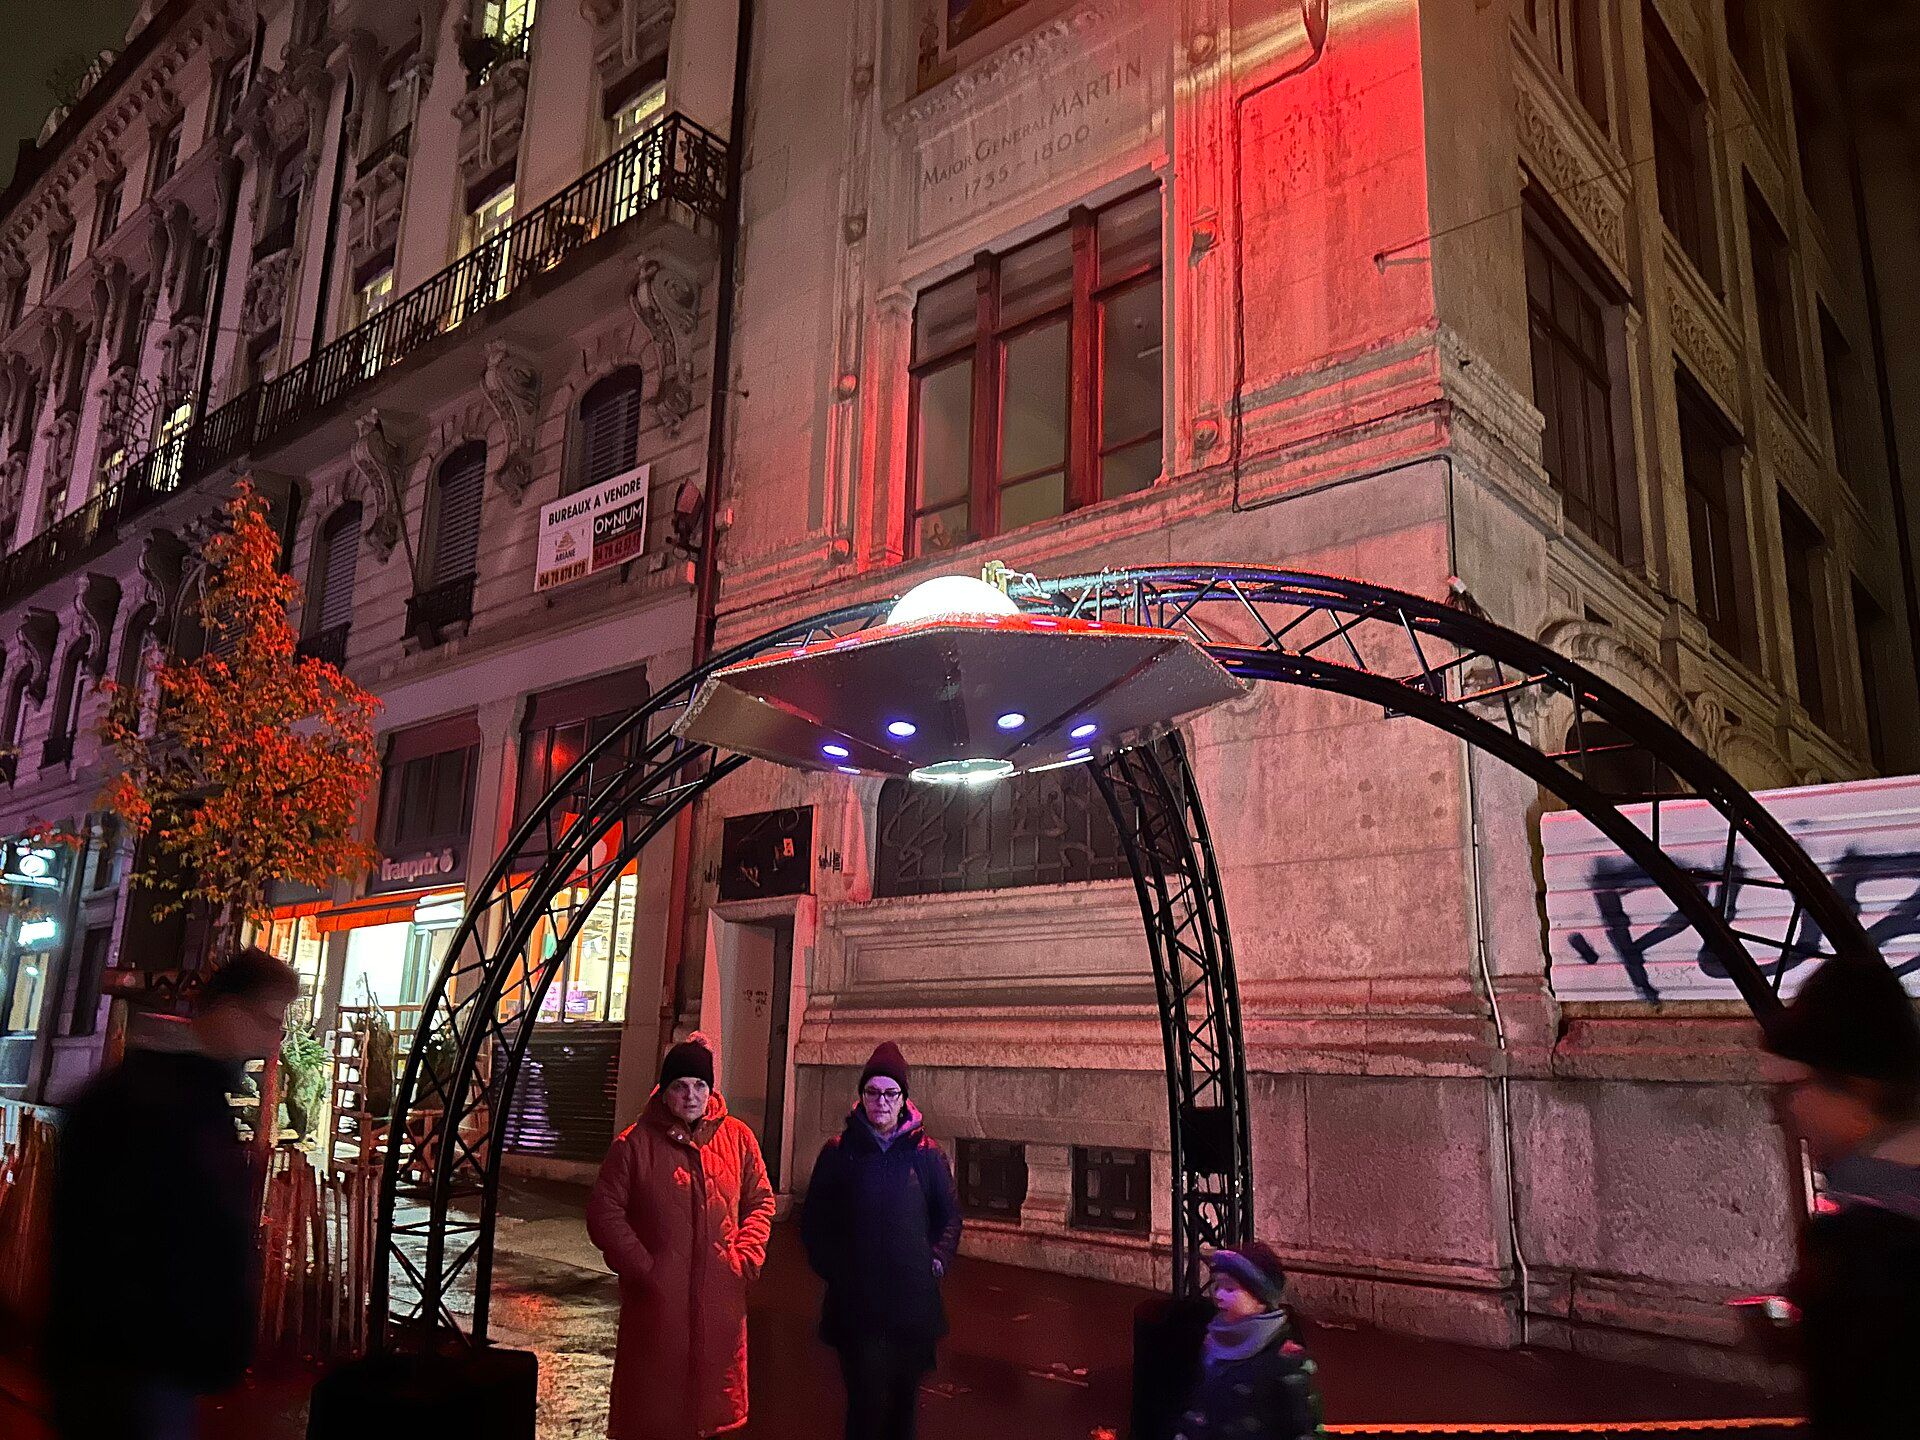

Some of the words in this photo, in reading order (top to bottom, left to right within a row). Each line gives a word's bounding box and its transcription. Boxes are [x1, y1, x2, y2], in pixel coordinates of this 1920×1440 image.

[1048, 56, 1142, 126] MARTIN
[1034, 124, 1090, 166] 1800
[548, 498, 591, 526] BUREAUX
[593, 494, 601, 510] A
[603, 477, 641, 505] VENDRE
[594, 502, 643, 534] OMNIUM
[381, 851, 439, 882] franprix
